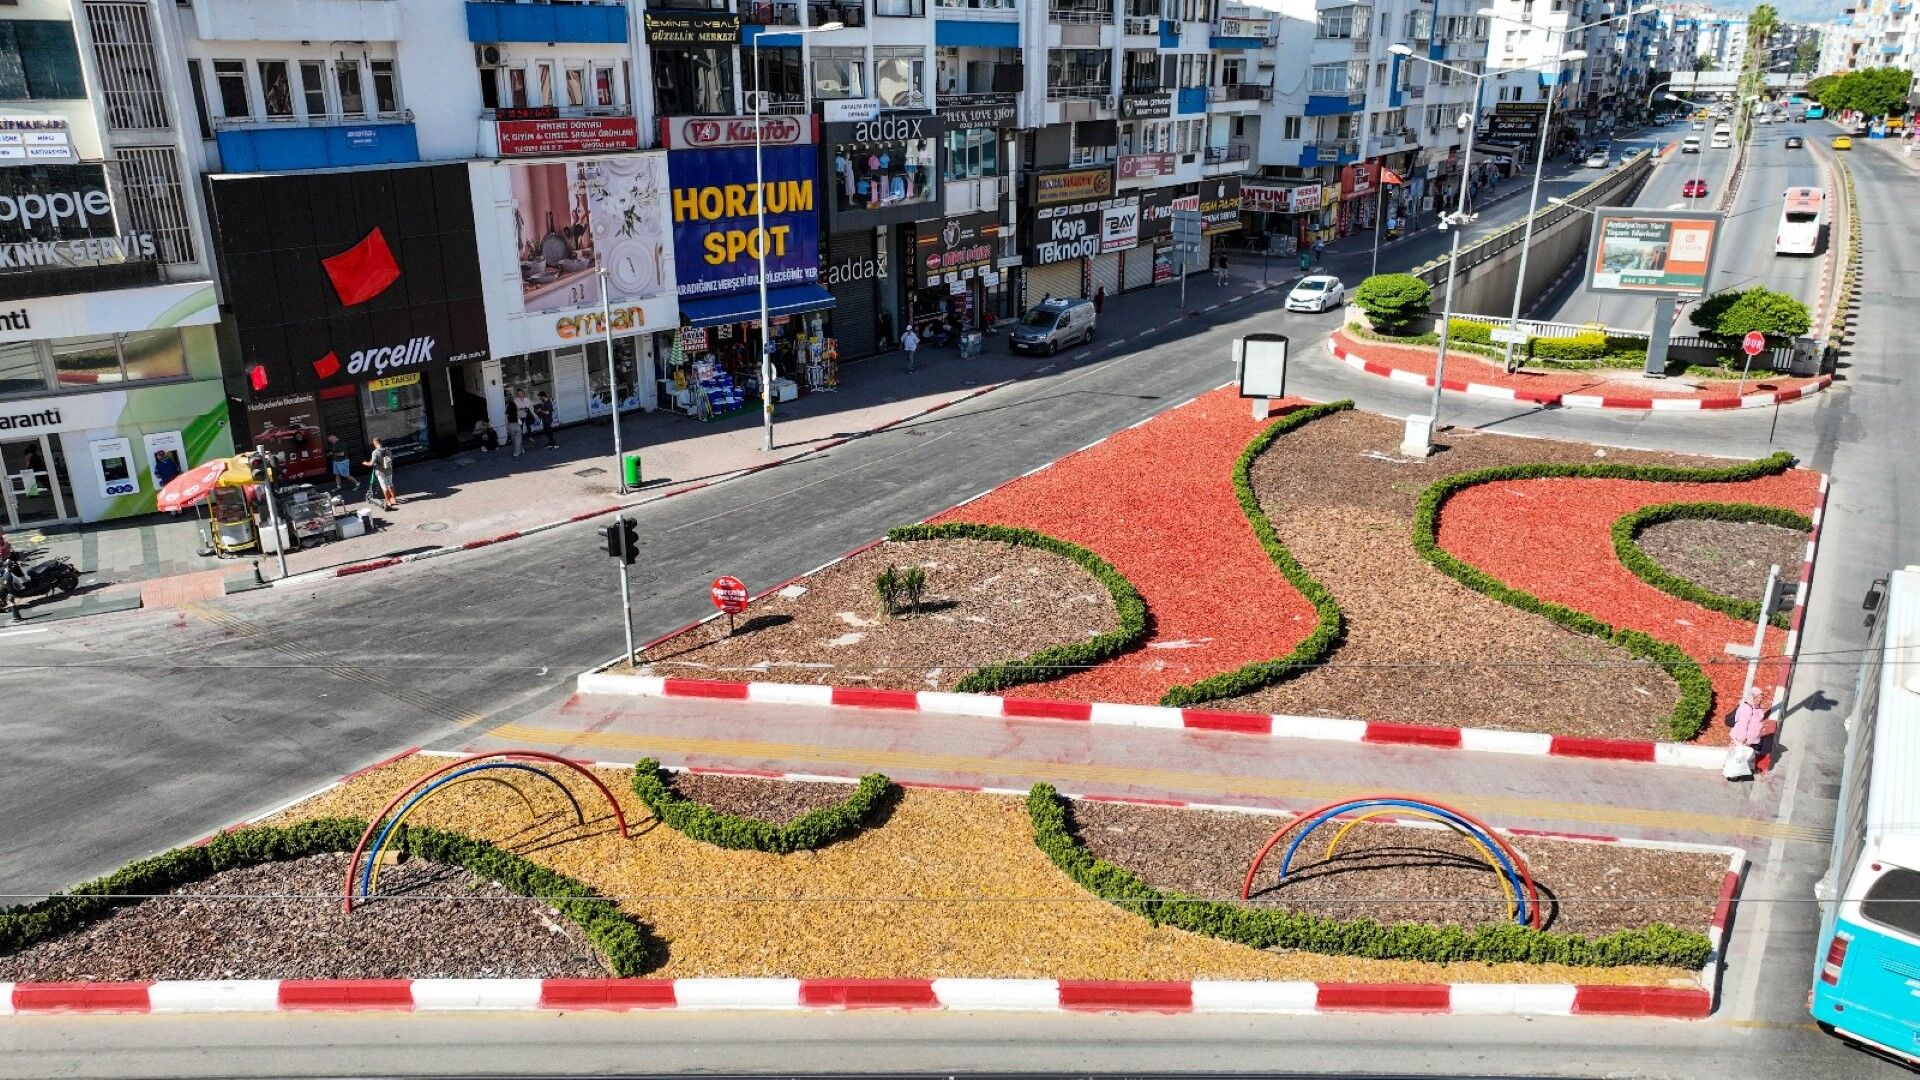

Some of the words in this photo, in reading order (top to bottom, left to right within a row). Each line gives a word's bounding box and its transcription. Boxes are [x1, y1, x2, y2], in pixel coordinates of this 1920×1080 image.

[652, 30, 694, 41] GÜZELLİK
[698, 31, 736, 41] MERKEZİ
[694, 20, 735, 28] UYSAL
[570, 120, 602, 129] DÜNYASI
[970, 109, 991, 121] LOVE
[994, 106, 1015, 121] SHOP
[726, 119, 794, 141] Kuaför
[856, 114, 922, 142] addax
[673, 179, 813, 223] HORZUM
[1173, 197, 1198, 211] AYDIN
[1051, 218, 1086, 241] Kaya
[1105, 212, 1136, 235] BAY
[69, 229, 157, 260] SERVİS
[703, 224, 790, 265] SPOT
[1036, 233, 1100, 265] Teknoloji
[804, 266, 817, 278] YER
[828, 255, 885, 284] addax
[1746, 337, 1761, 350] DUR
[347, 336, 435, 376] arçelik
[0, 408, 62, 434] aranti
